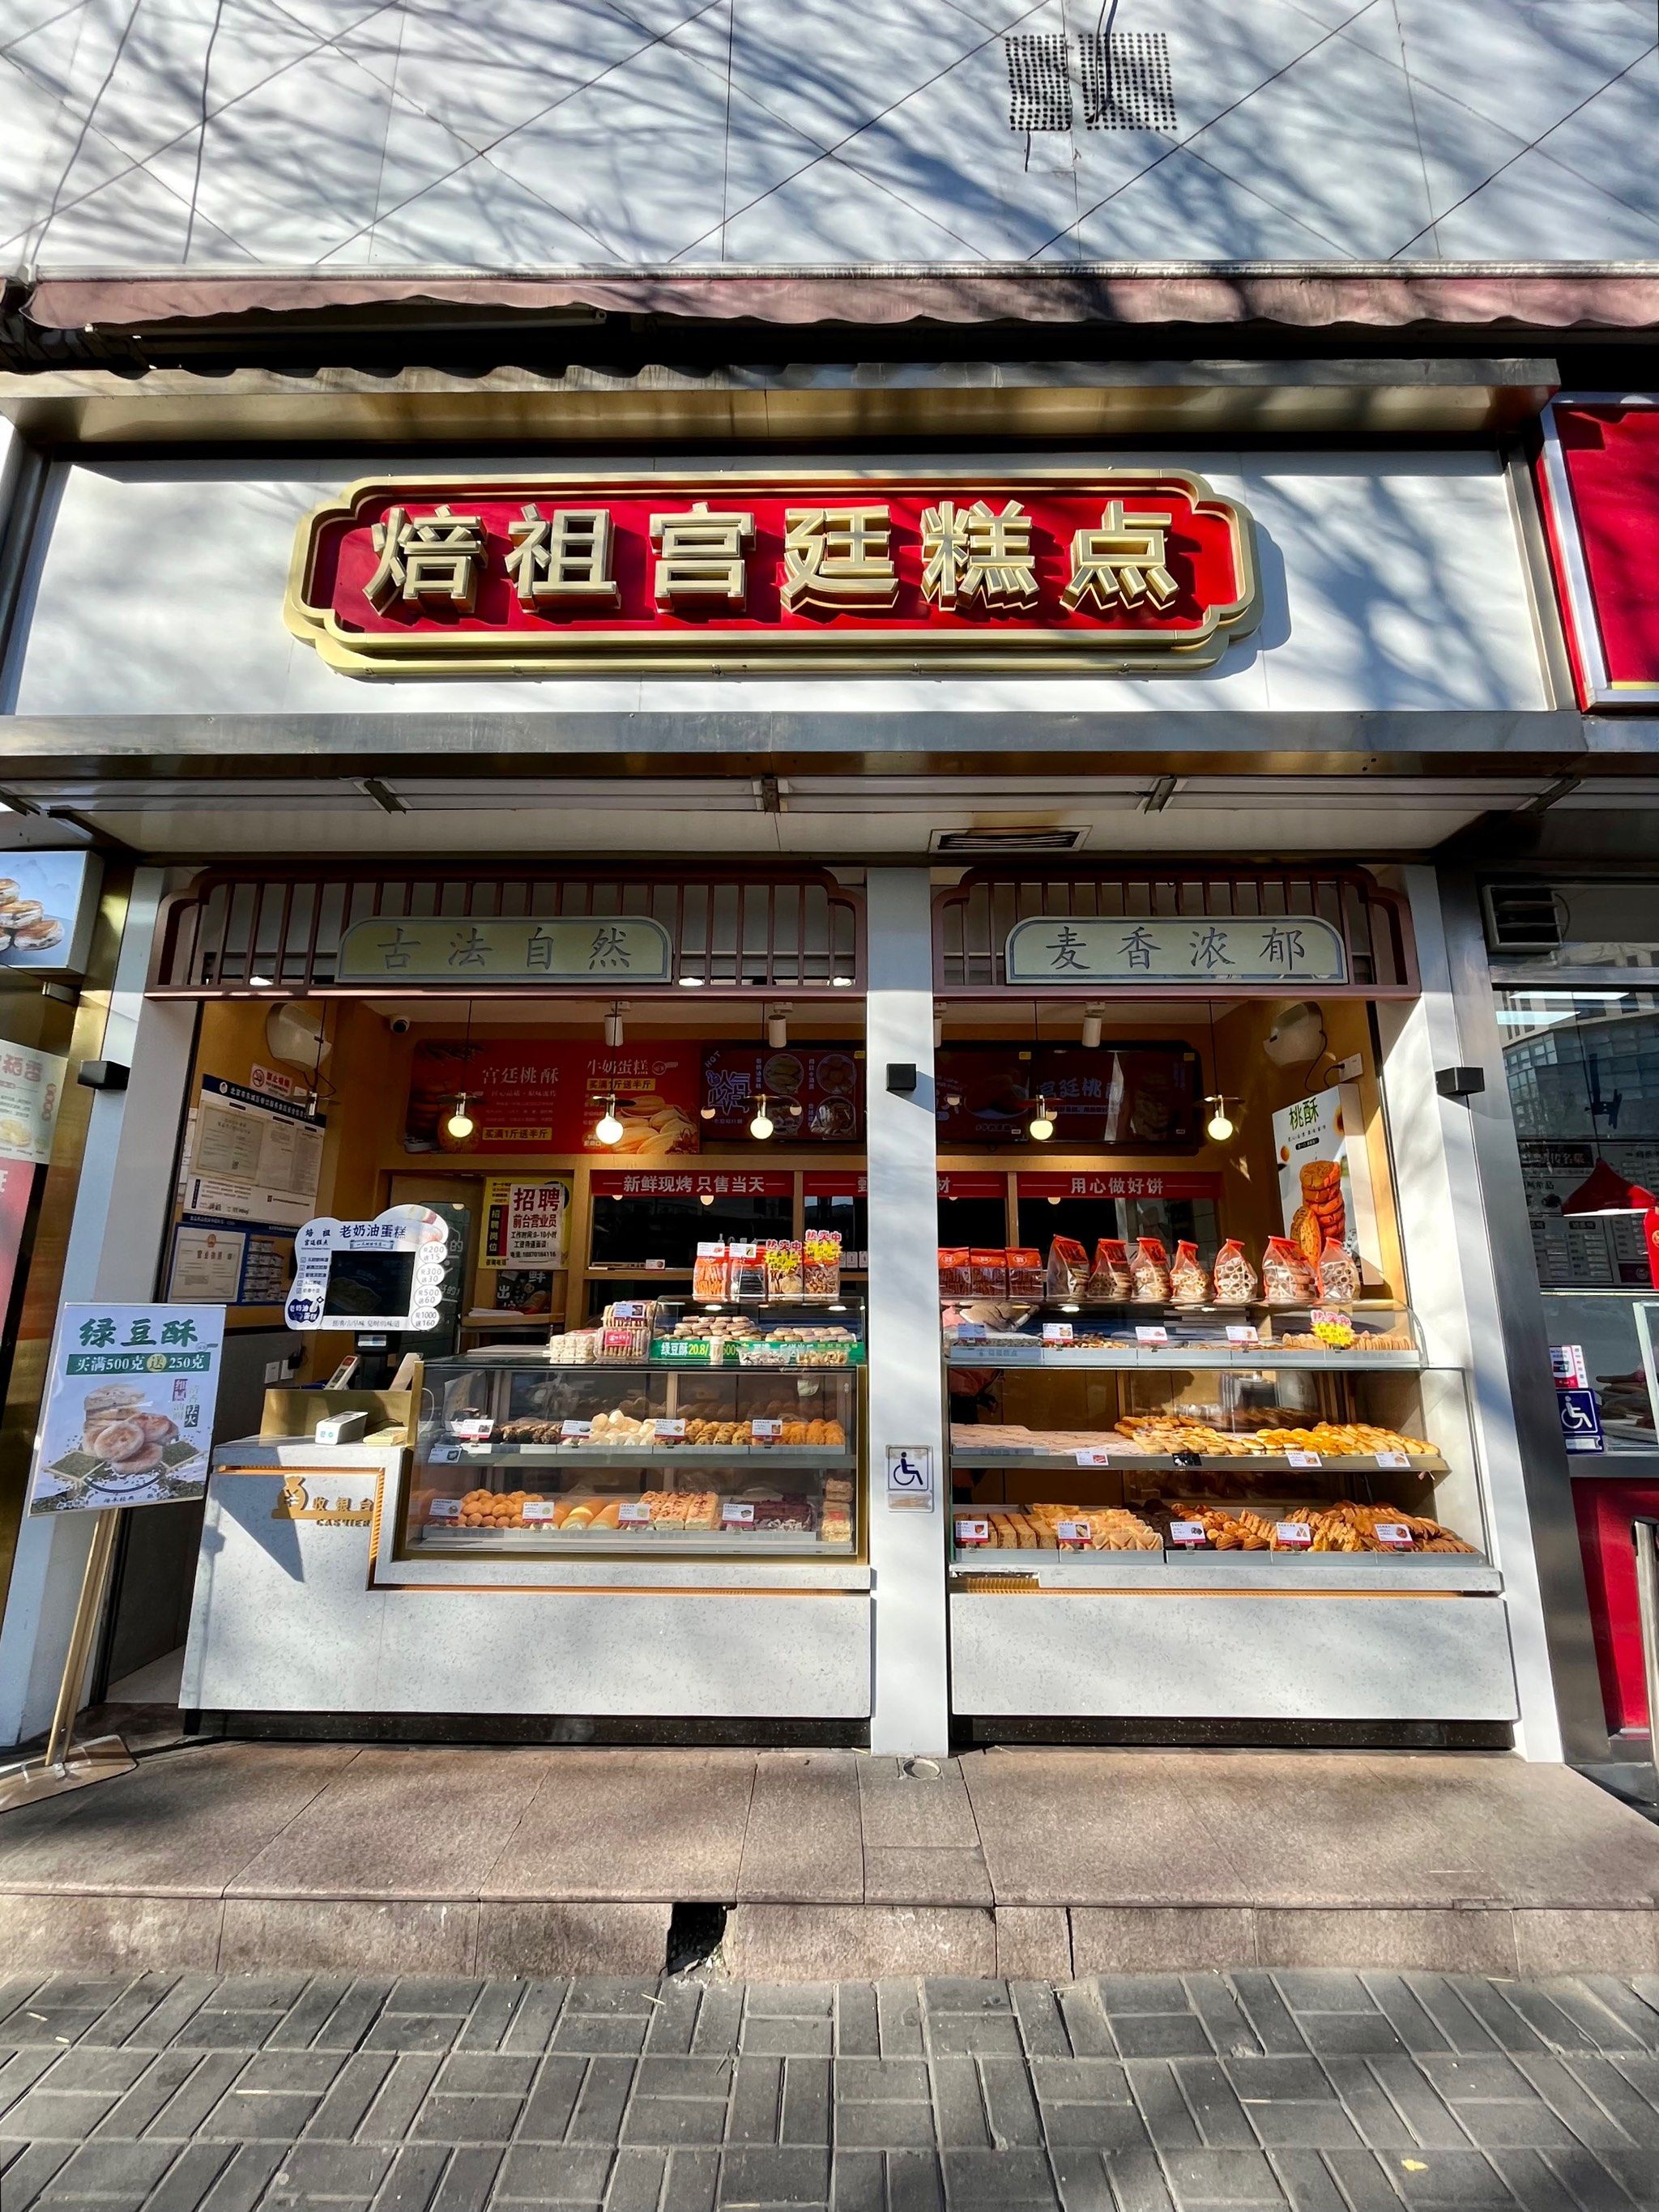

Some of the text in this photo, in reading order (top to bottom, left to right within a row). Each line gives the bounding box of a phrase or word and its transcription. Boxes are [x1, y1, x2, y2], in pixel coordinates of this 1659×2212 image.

[362, 500, 1180, 613] 焙祖宫廷糕点
[377, 926, 632, 970] 古法自然
[1045, 926, 1306, 971] 麦香浓郁
[482, 1066, 559, 1085] 宫廷桃酥
[1289, 1097, 1320, 1132] 桃酥
[1071, 1177, 1164, 1195] 用心做好饼
[513, 1187, 560, 1212] 招聘
[339, 1224, 407, 1239] 老奶油蛋糕
[513, 1214, 557, 1229] 前台营业员
[497, 1285, 510, 1299] 出
[79, 1318, 198, 1348] 绿豆酥
[313, 1496, 375, 1511] 收银台
